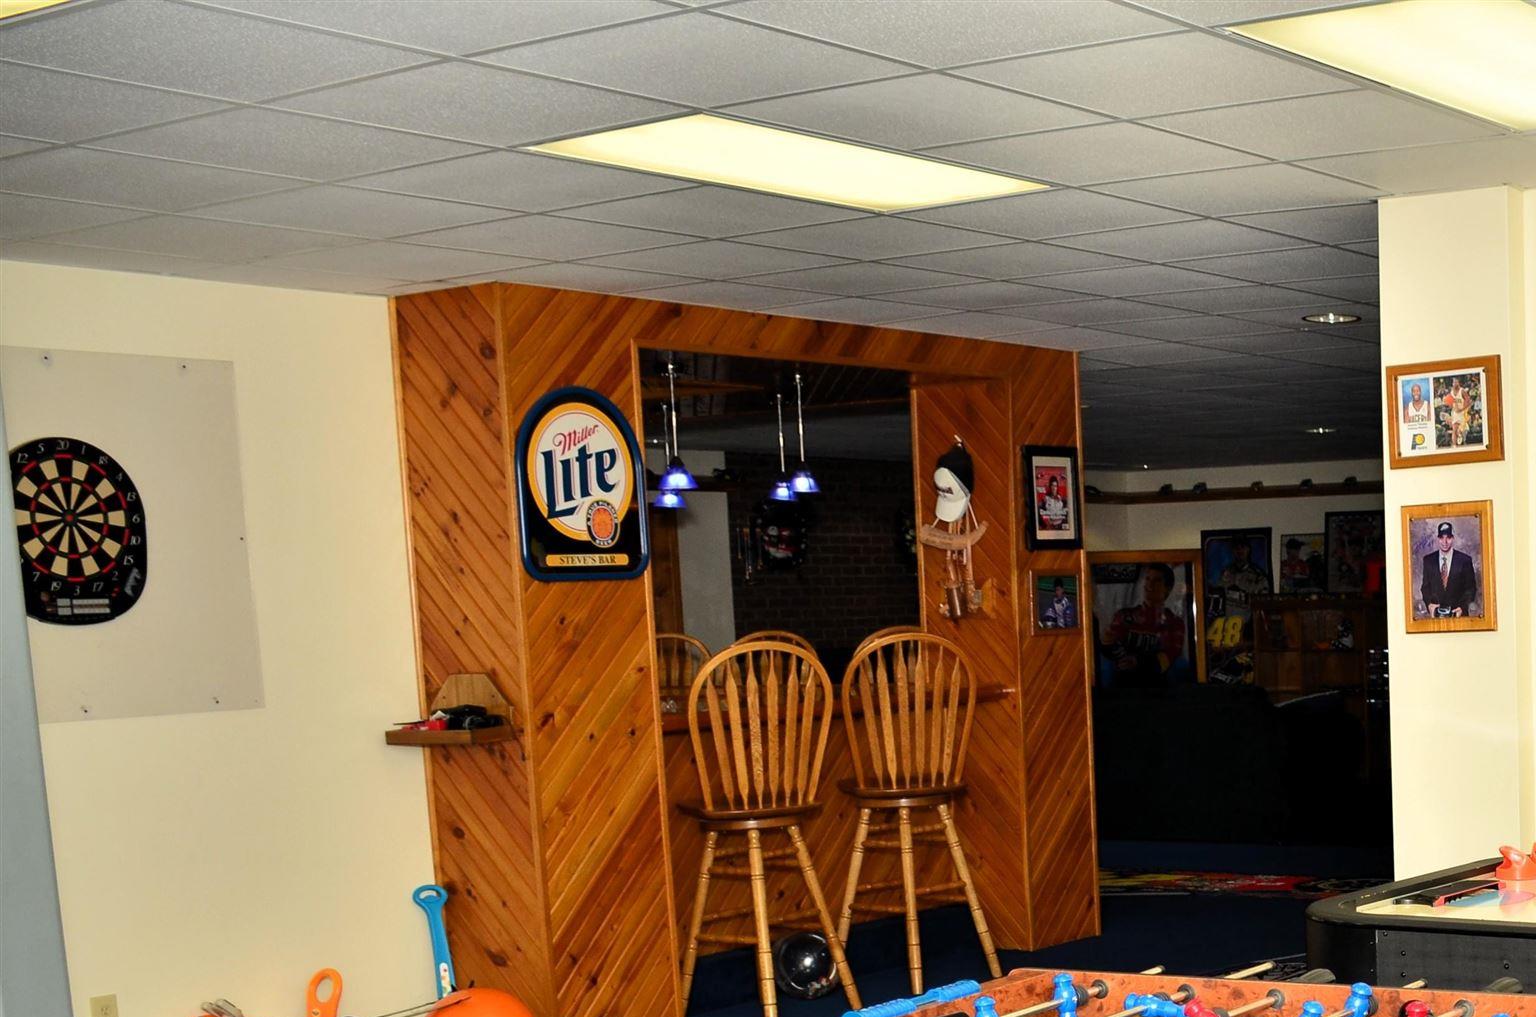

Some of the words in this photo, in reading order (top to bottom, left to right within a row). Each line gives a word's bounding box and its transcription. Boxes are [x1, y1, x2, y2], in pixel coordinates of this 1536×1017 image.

[552, 424, 600, 456] Miller
[17, 452, 29, 463] 12
[540, 444, 620, 520] Lite
[132, 514, 140, 524] 6
[130, 535, 142, 545] 10
[123, 555, 134, 566] 15
[559, 555, 597, 565] STEVE'S
[598, 555, 617, 564] BAR
[32, 571, 40, 582] 7
